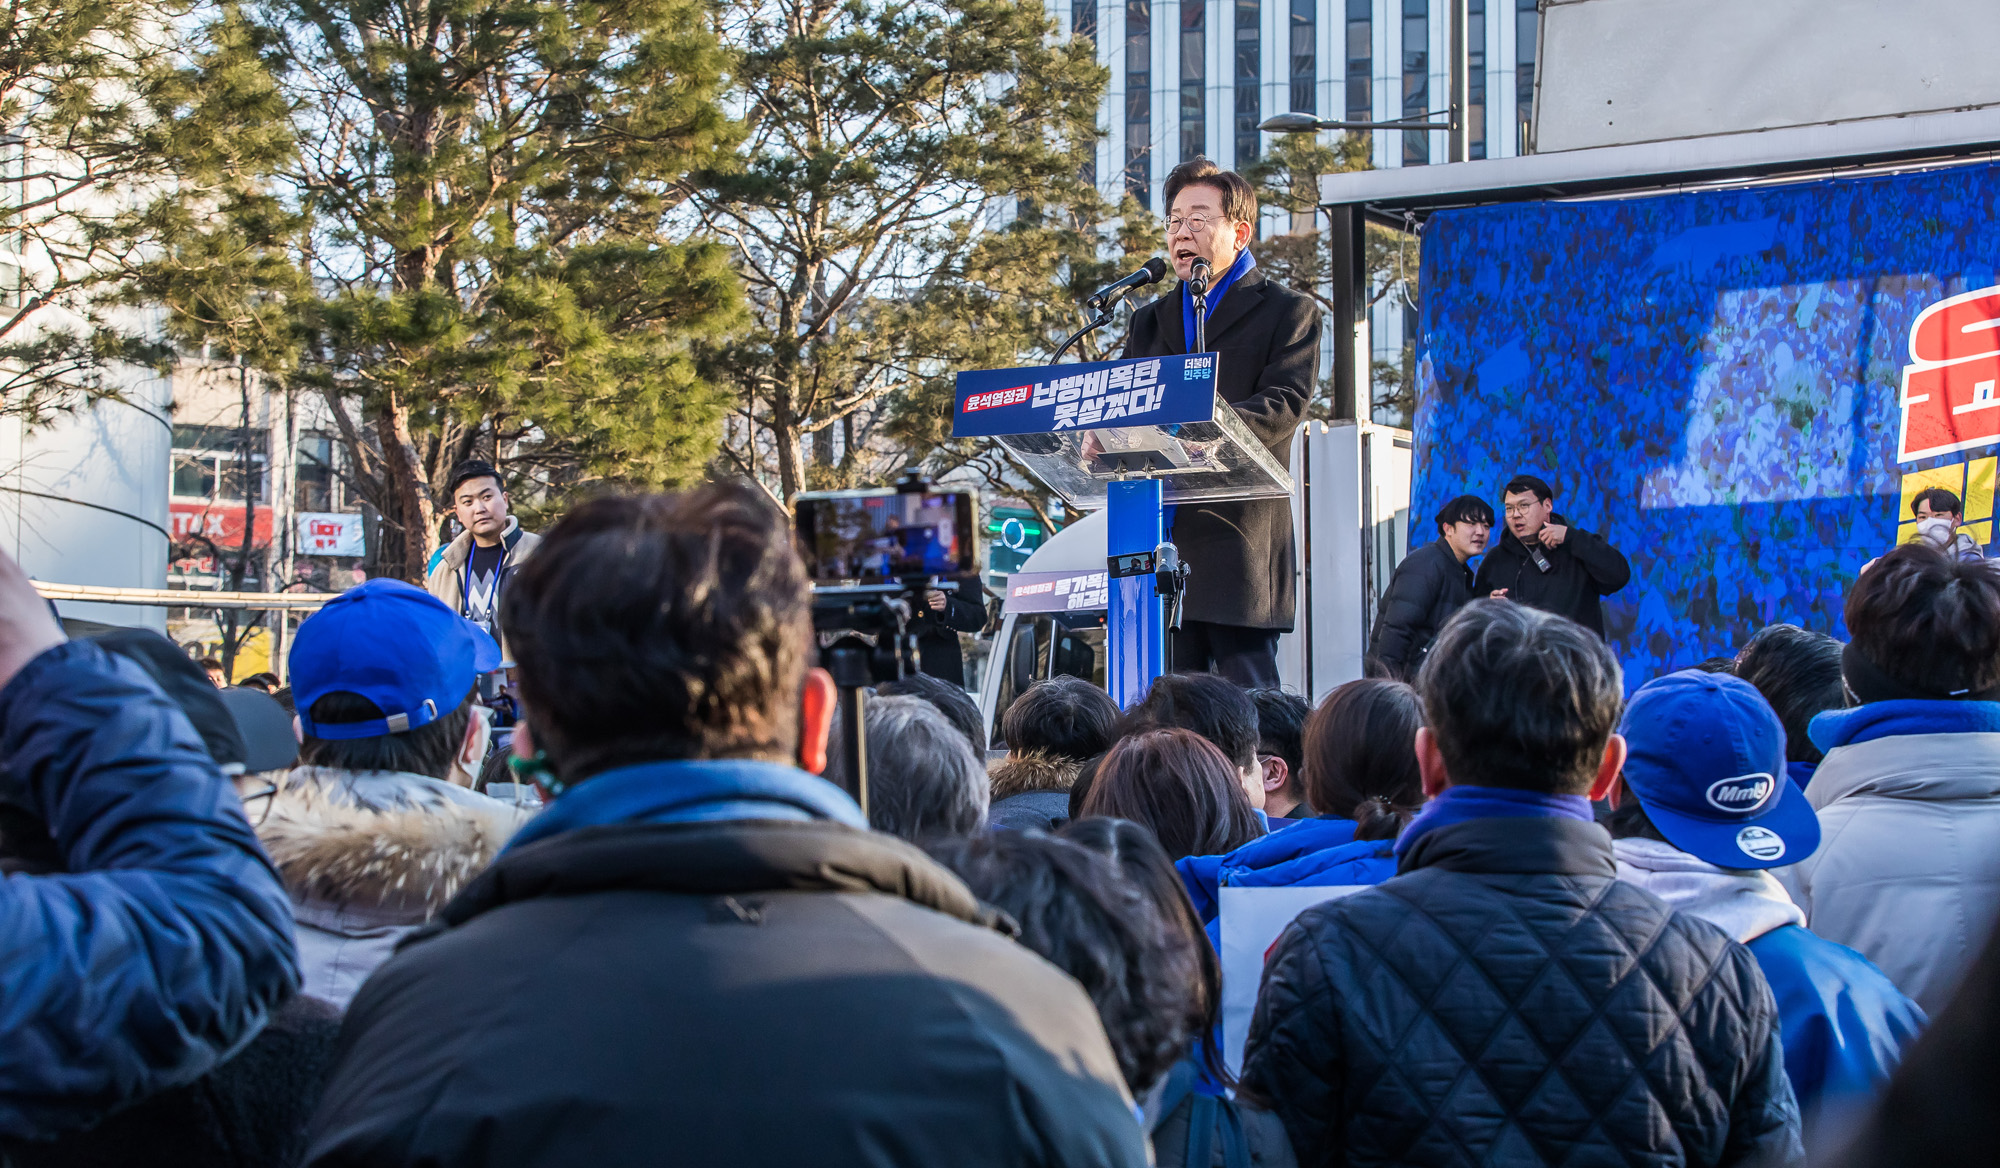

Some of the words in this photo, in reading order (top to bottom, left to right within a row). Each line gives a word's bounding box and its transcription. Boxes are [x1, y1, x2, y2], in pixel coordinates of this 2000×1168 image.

[1184, 356, 1212, 369] 더불어
[1184, 368, 1212, 381] 민주당
[967, 387, 1028, 411] 윤석열정권
[1031, 359, 1162, 409] 난방비폭탄
[1052, 384, 1166, 431] 못살겠다!
